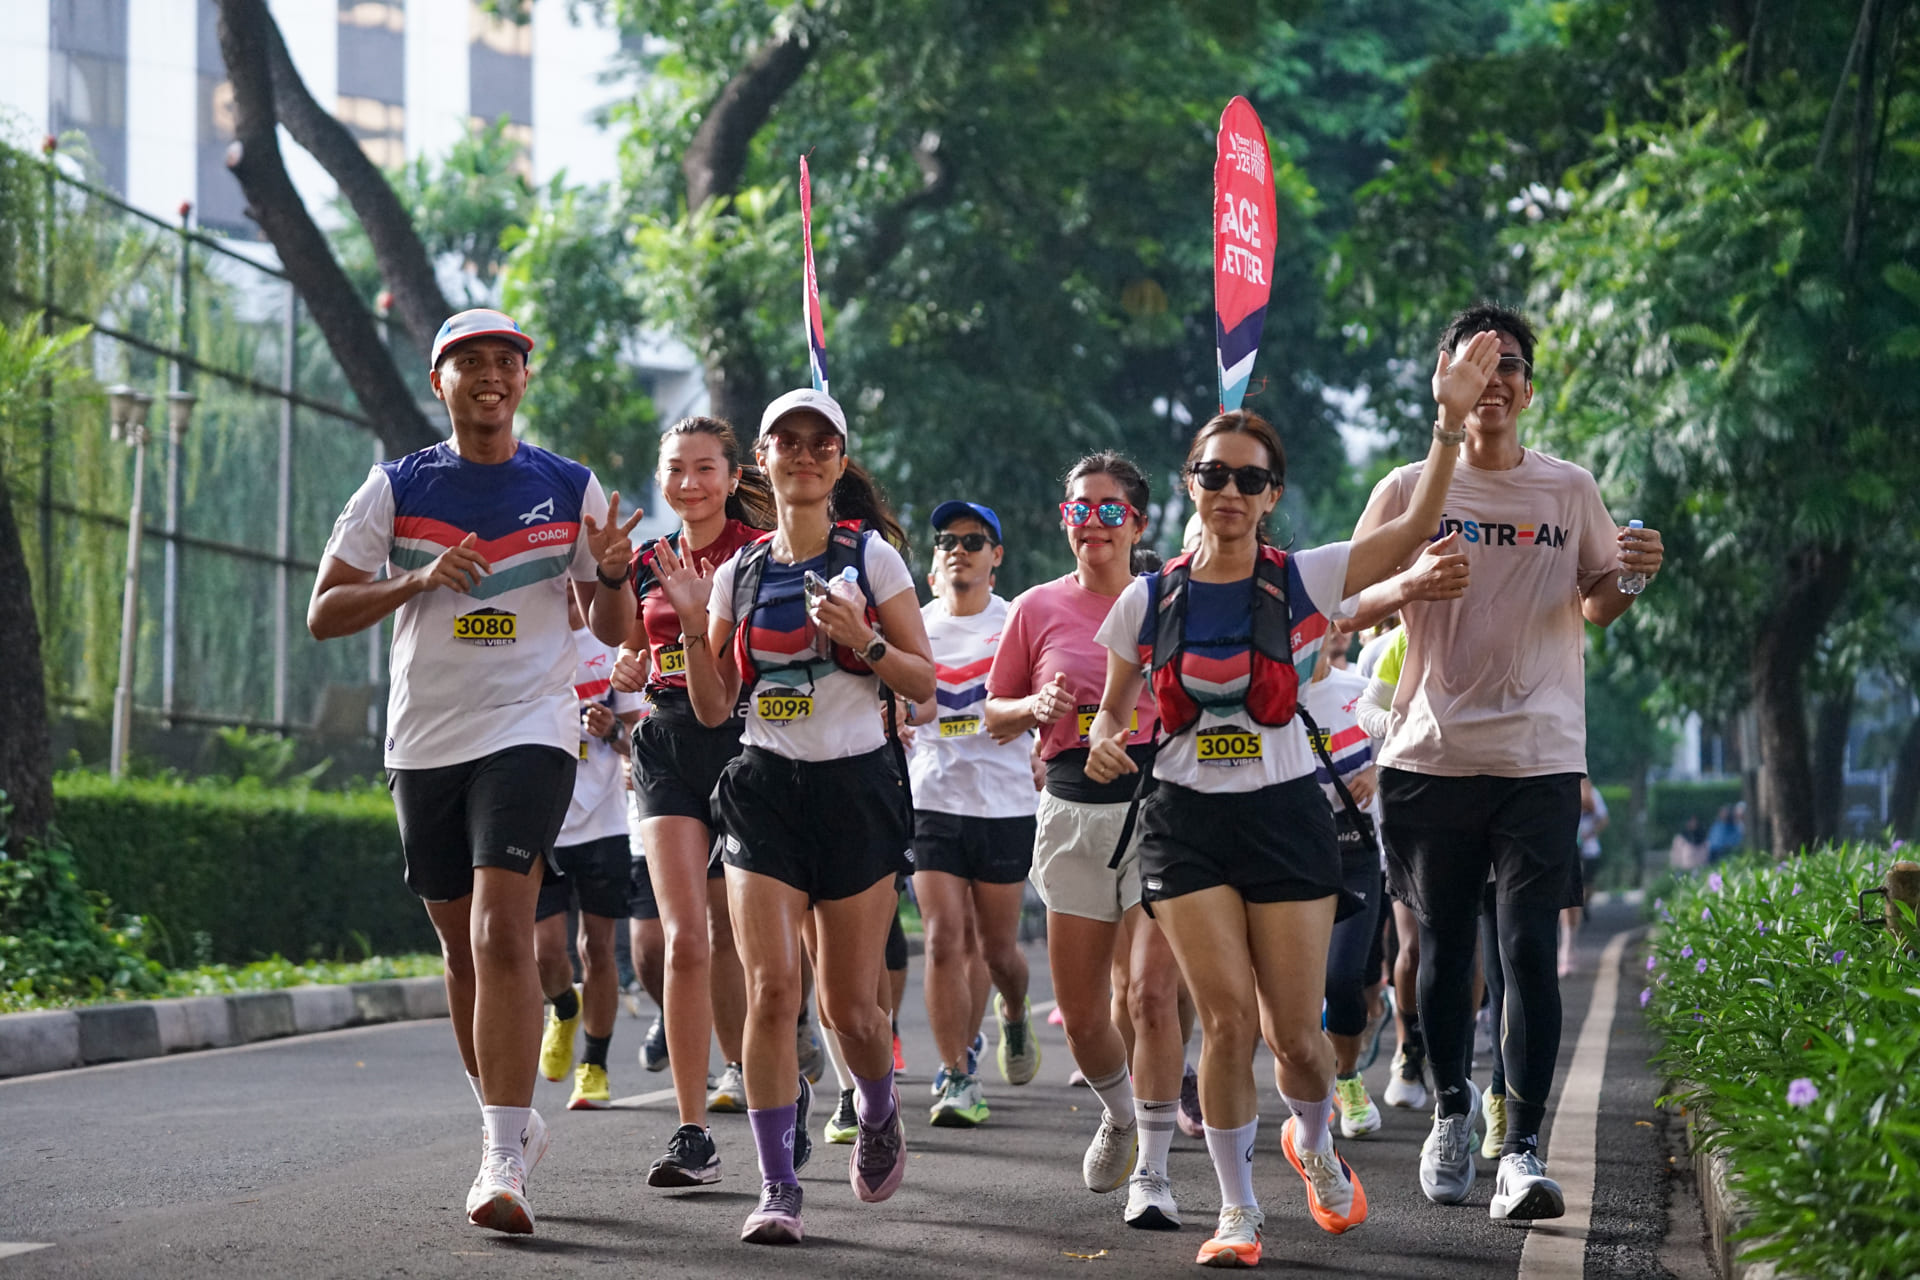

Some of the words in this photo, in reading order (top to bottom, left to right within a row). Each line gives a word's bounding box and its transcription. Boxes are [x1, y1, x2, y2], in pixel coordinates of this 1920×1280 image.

[1222, 244, 1267, 285] ETTER
[528, 528, 569, 543] COACH
[457, 618, 514, 635] 3080
[761, 700, 810, 717] 3098
[1201, 737, 1259, 756] 3005
[506, 846, 530, 859] 2XU
